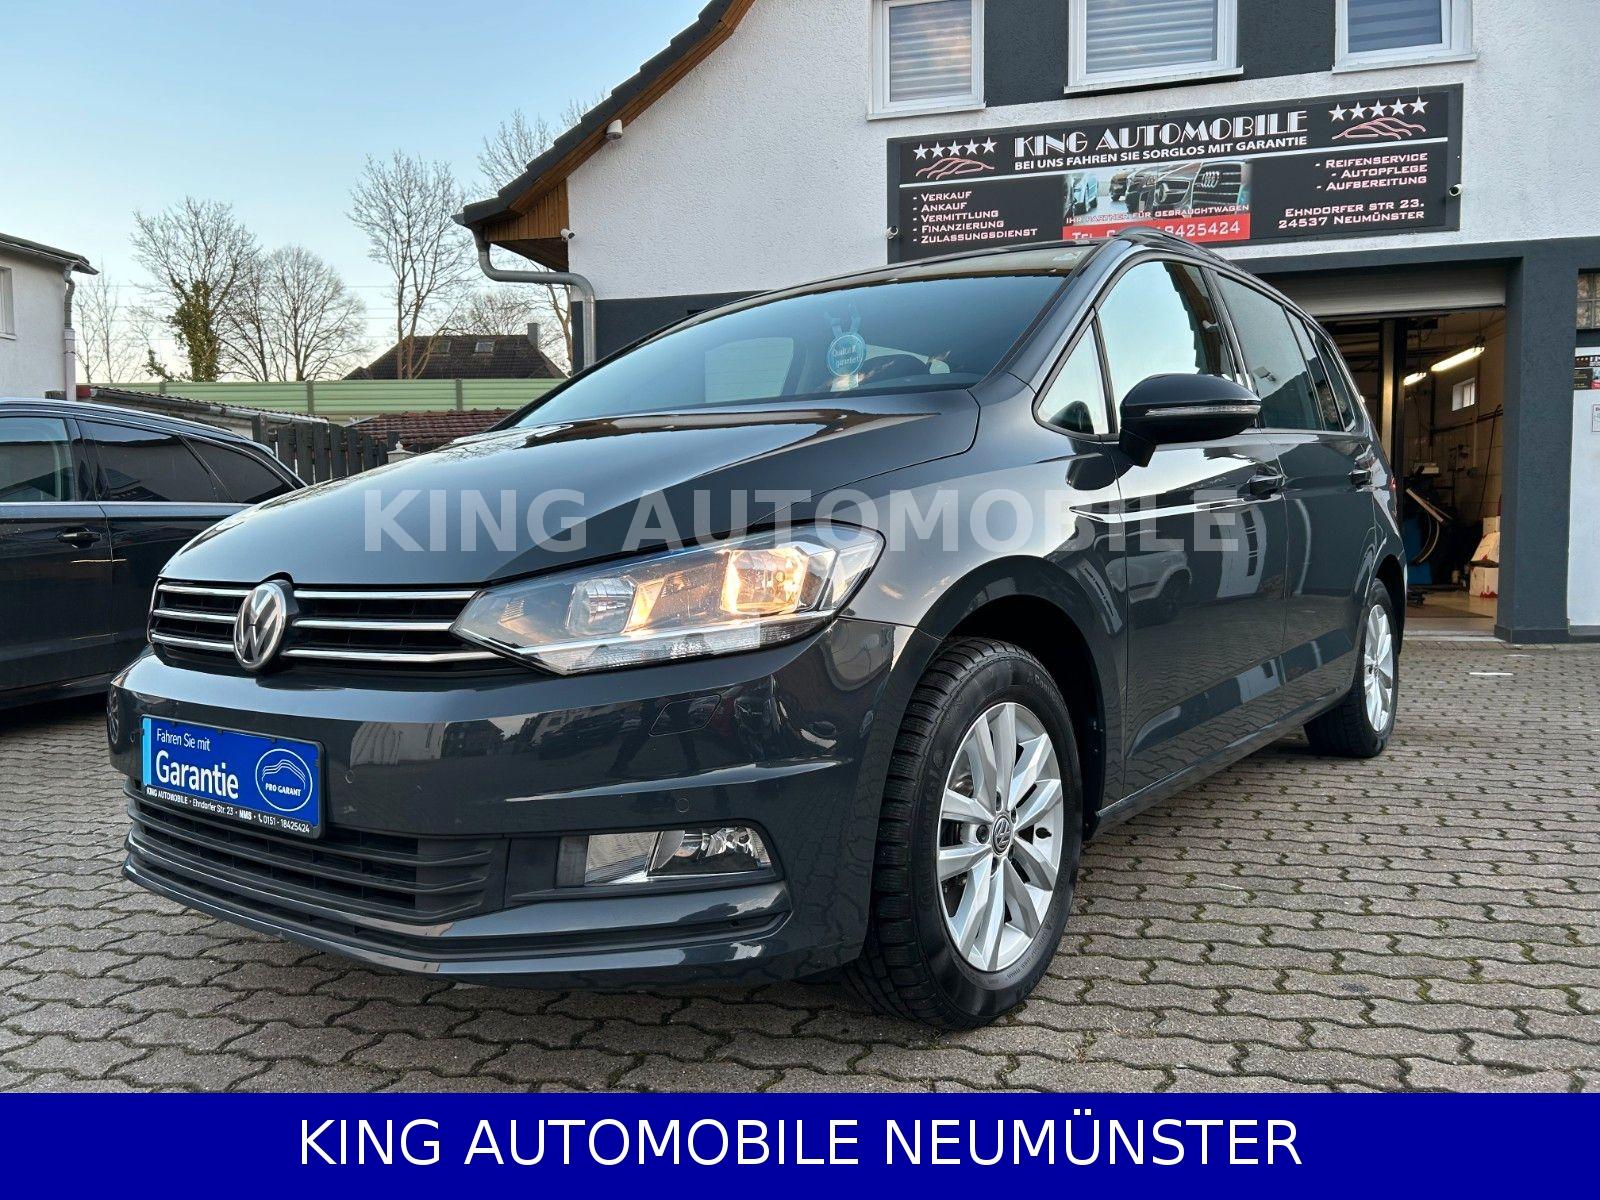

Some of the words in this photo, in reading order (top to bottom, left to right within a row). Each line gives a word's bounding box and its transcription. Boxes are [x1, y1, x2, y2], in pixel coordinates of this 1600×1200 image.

[1014, 131, 1088, 158] KING
[1095, 110, 1307, 150] AUTOMOBILE
[1014, 161, 1034, 171] BEI
[1037, 158, 1063, 169] UNS
[1066, 153, 1118, 167] FAHREN
[1121, 150, 1140, 161] SIE
[1142, 143, 1204, 160] SORGLOS
[1208, 141, 1233, 154] MIT
[1236, 135, 1307, 151] GARANTIE
[1326, 152, 1428, 169] REIFENSERVICE
[1341, 164, 1428, 179] AUTOPFLEGE
[1326, 175, 1427, 191] AUFBEREITUNG
[921, 191, 972, 202] VERKAUF
[921, 202, 967, 211] ANKAUF
[1131, 210, 1151, 219] FÜR
[1154, 204, 1250, 218] GEBRAUCHTWAGEN
[1285, 203, 1367, 218] EHNDORFER
[1399, 198, 1425, 209] 23.
[921, 210, 999, 223] VERMITTLUNG
[1278, 217, 1327, 229] 24537
[1333, 210, 1425, 225] NEUMÜNSTER
[922, 220, 1004, 233] FINANZIERUNG
[1156, 221, 1241, 237] 8425424
[921, 228, 1038, 244] ZULASSUNGSDIENST
[156, 728, 182, 746] Fahren
[184, 733, 196, 749] Sie
[197, 736, 211, 752] mit
[155, 749, 239, 799] Garantie
[265, 782, 277, 792] PRO
[277, 786, 302, 797] GARANT
[146, 787, 158, 797] KING
[158, 789, 188, 805] AUTOMOBILE
[192, 798, 217, 813] Ehndorfer
[226, 806, 234, 816] 23
[264, 814, 276, 826] 0151
[280, 818, 310, 834] 18425424
